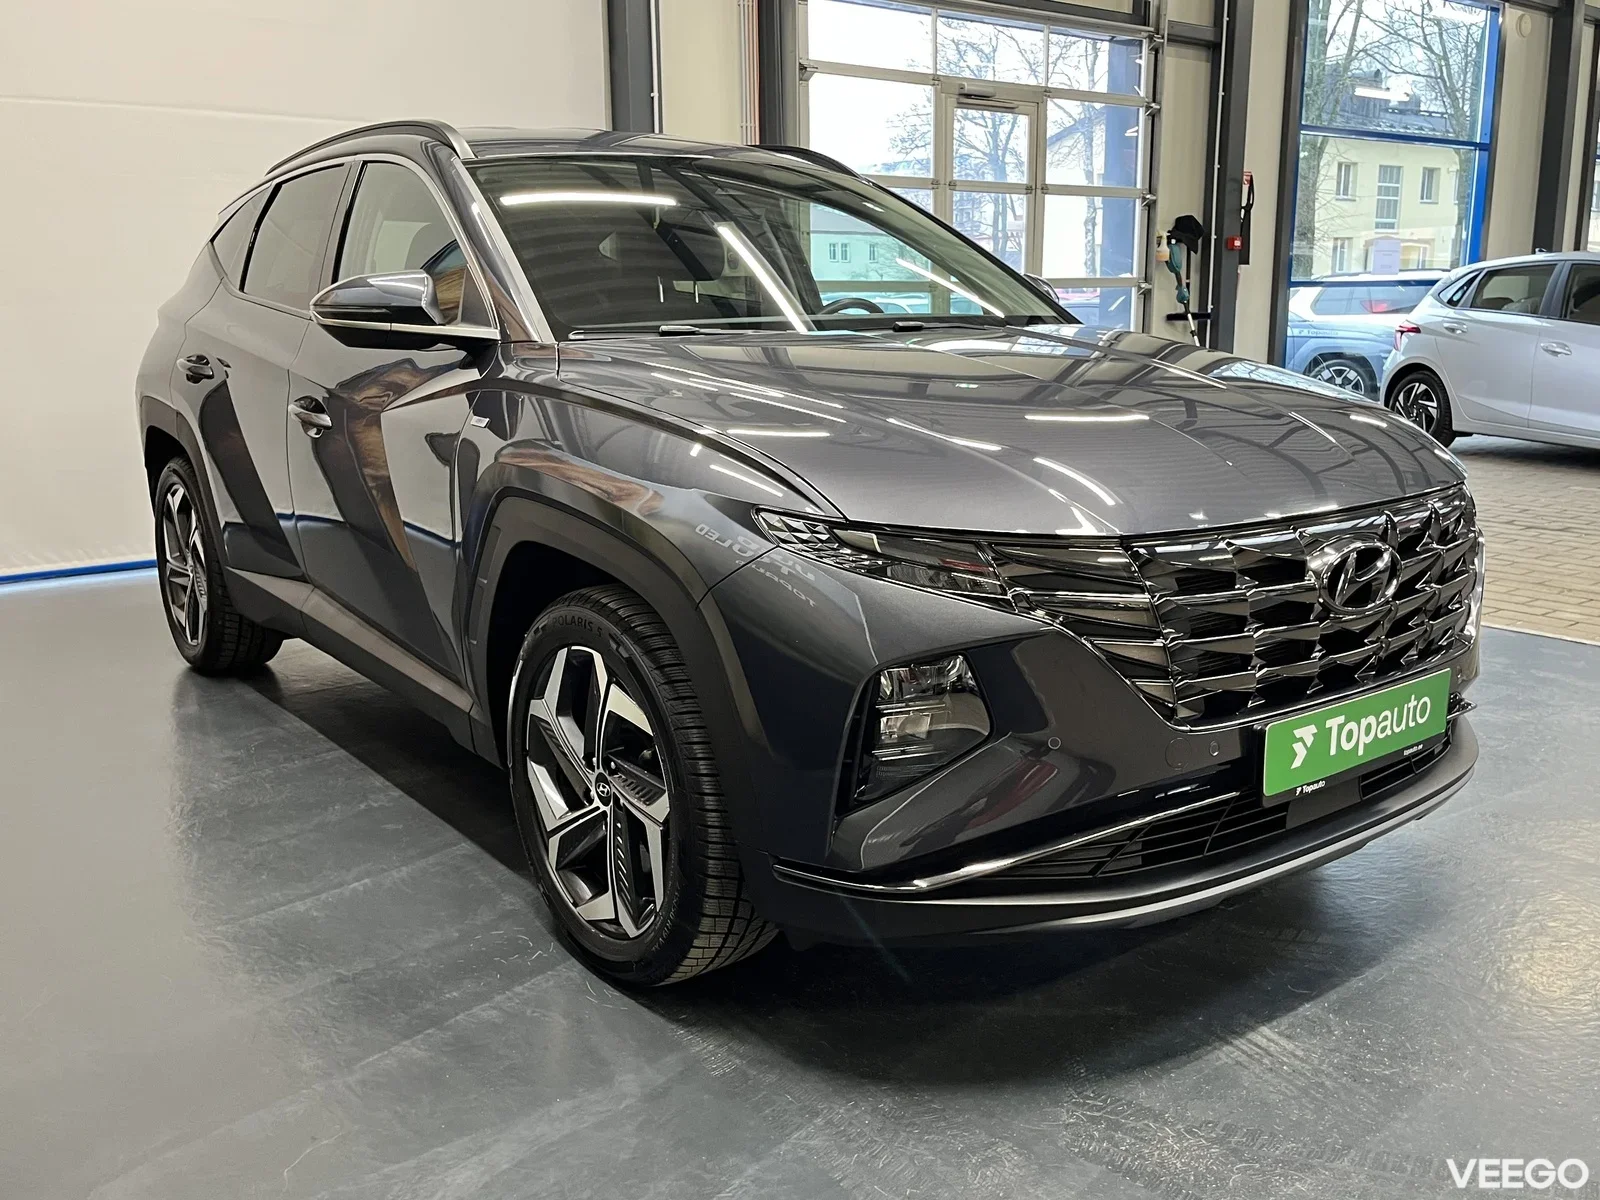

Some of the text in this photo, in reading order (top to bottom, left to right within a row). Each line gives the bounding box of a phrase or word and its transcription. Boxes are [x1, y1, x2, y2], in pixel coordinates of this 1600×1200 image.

[553, 615, 594, 632] POLARIS
[1325, 694, 1431, 756] Topauto
[1302, 780, 1326, 794] Topauto
